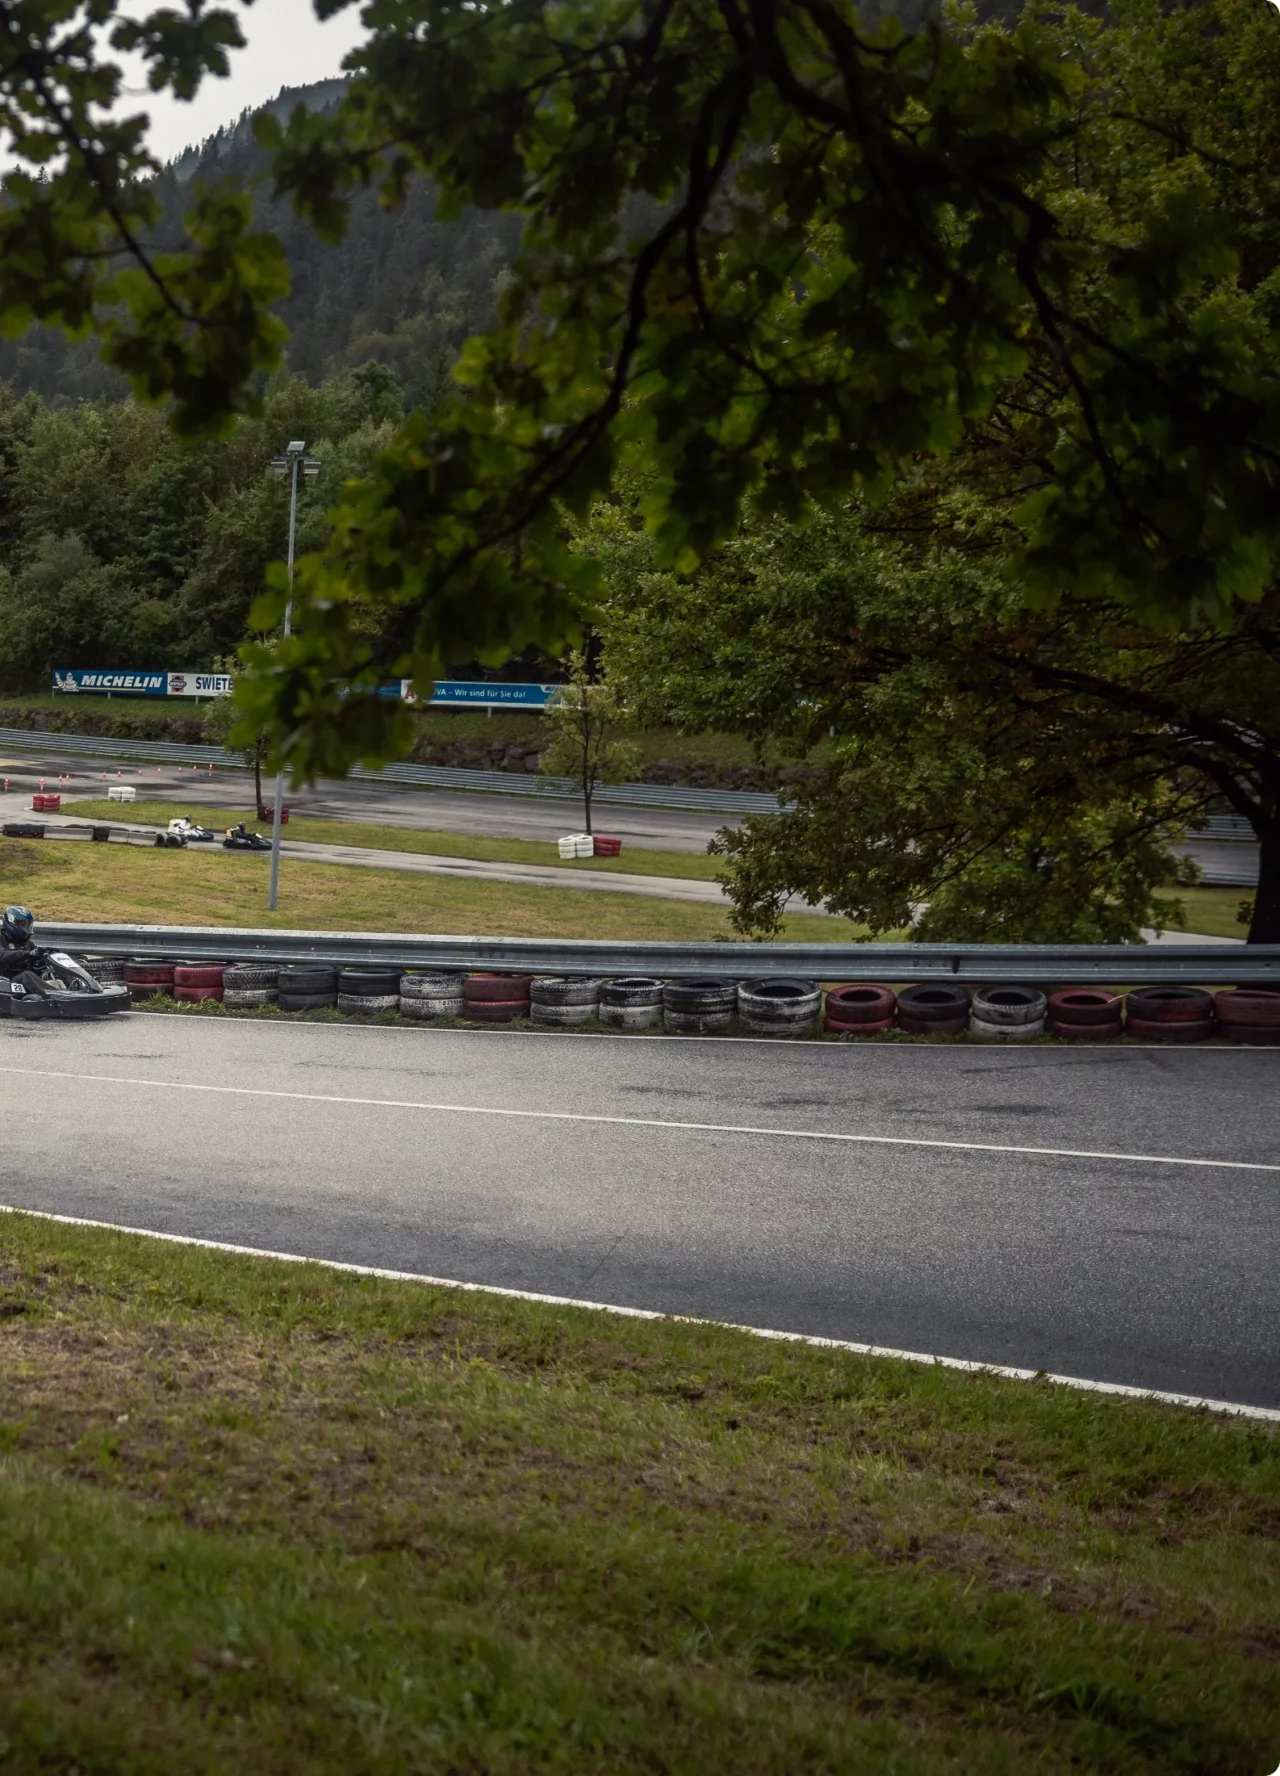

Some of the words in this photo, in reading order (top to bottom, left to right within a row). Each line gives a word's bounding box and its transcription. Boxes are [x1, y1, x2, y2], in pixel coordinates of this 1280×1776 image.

[81, 675, 163, 688] MICHELIN
[454, 688, 467, 696] Wir
[469, 689, 485, 697] sind
[487, 689, 498, 698] für
[500, 690, 511, 698] Sie
